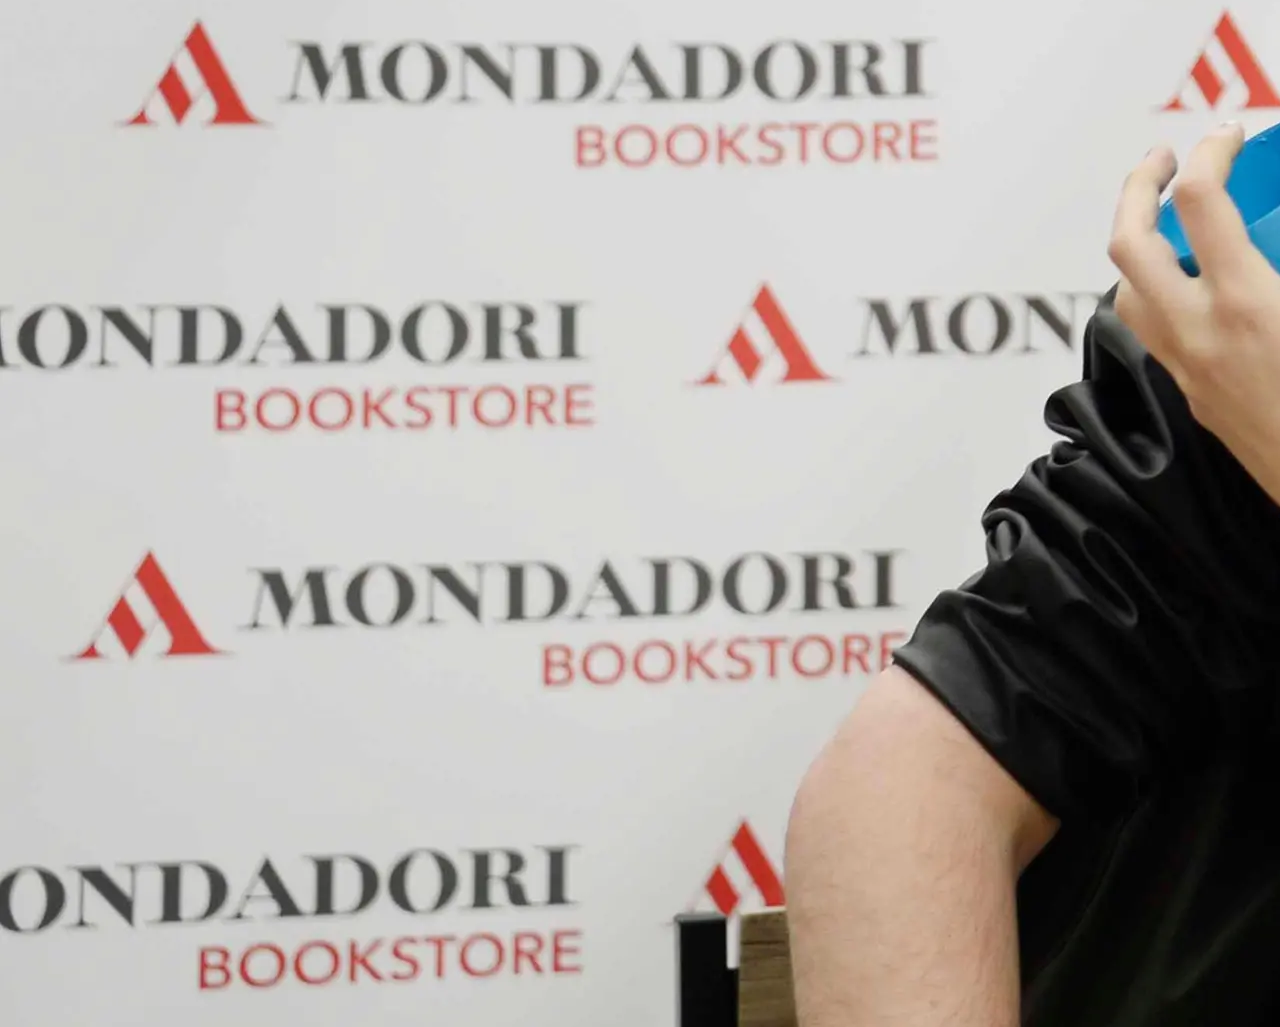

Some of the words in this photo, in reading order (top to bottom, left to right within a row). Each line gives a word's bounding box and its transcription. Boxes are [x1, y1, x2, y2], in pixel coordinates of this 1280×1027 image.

[281, 38, 936, 104] MONDADORI
[573, 119, 938, 169] BOOKSTORE
[0, 299, 592, 370] ONDADORI
[852, 291, 1103, 357] MON
[213, 383, 595, 434] BOOKSTORE
[243, 548, 908, 630] MONDADORI
[541, 629, 909, 688] BOOKSTORE
[196, 928, 585, 993] BOOKSTORE
